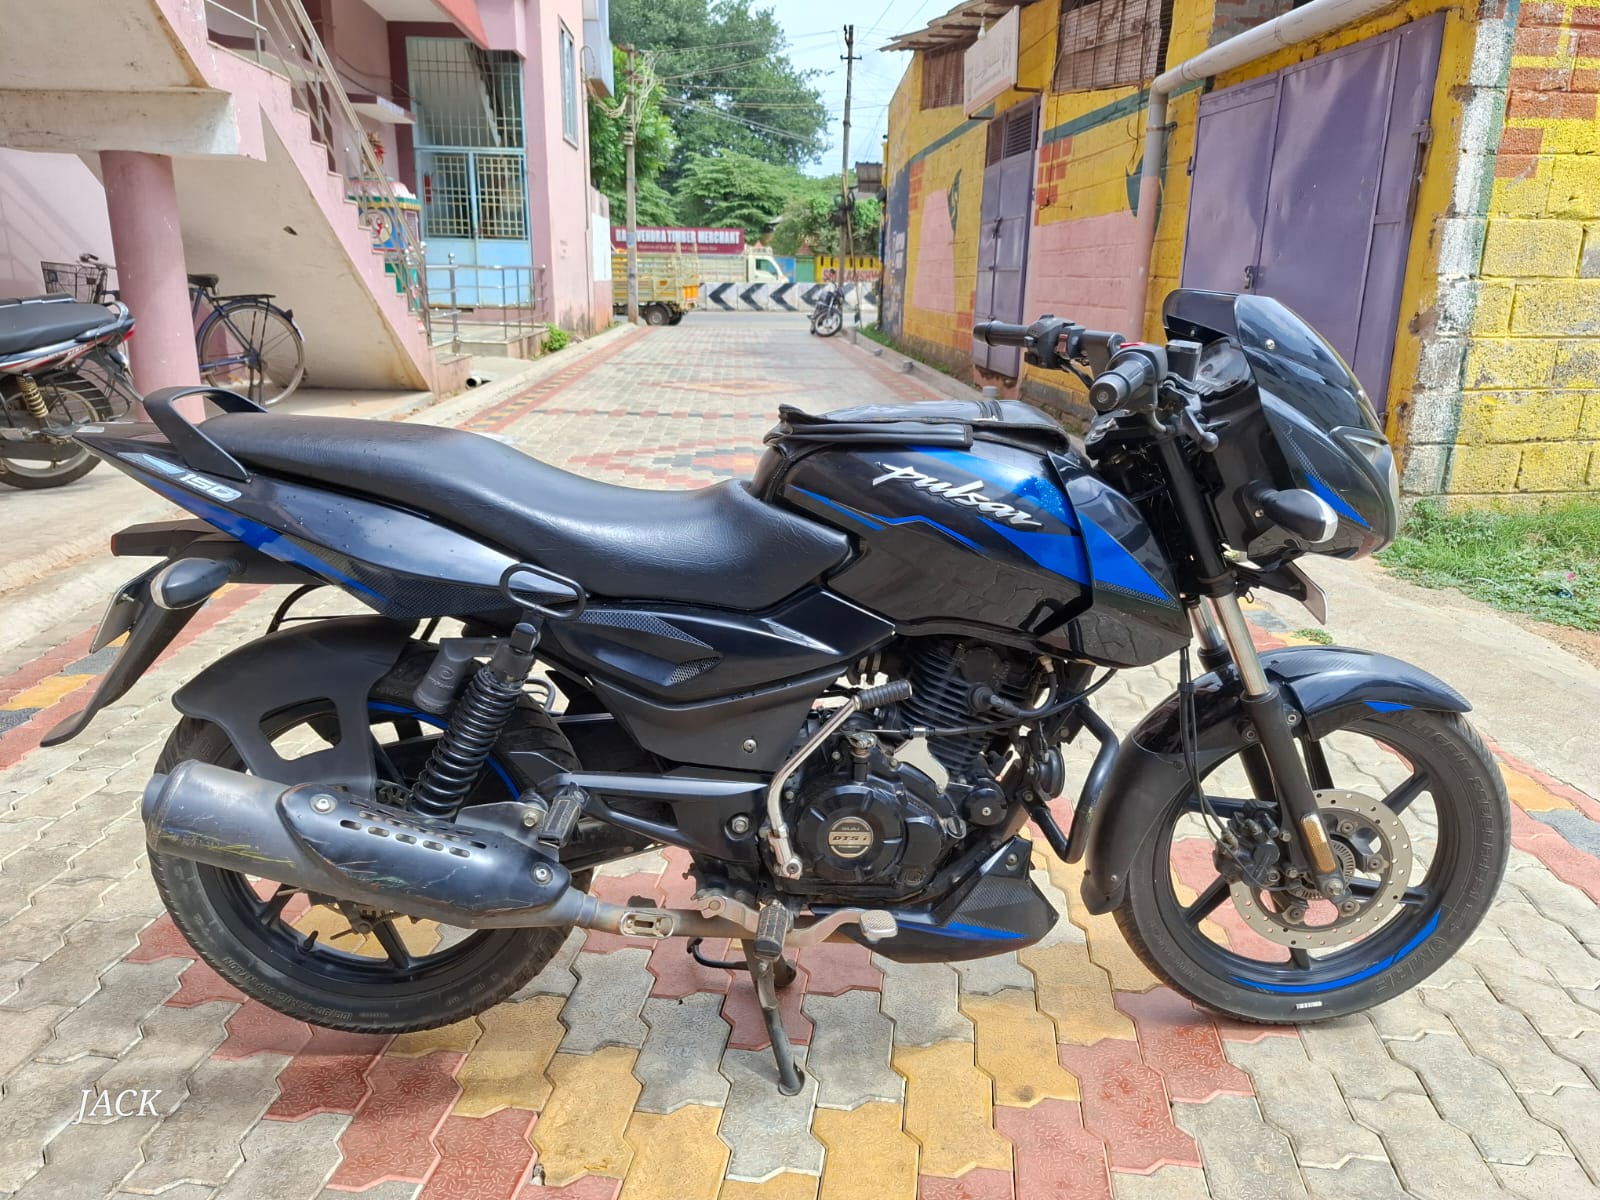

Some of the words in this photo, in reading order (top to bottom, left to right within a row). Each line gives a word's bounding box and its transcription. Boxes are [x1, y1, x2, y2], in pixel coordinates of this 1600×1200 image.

[667, 230, 696, 243] TIMBER
[698, 231, 739, 244] MERCHANT
[180, 473, 241, 502] 150
